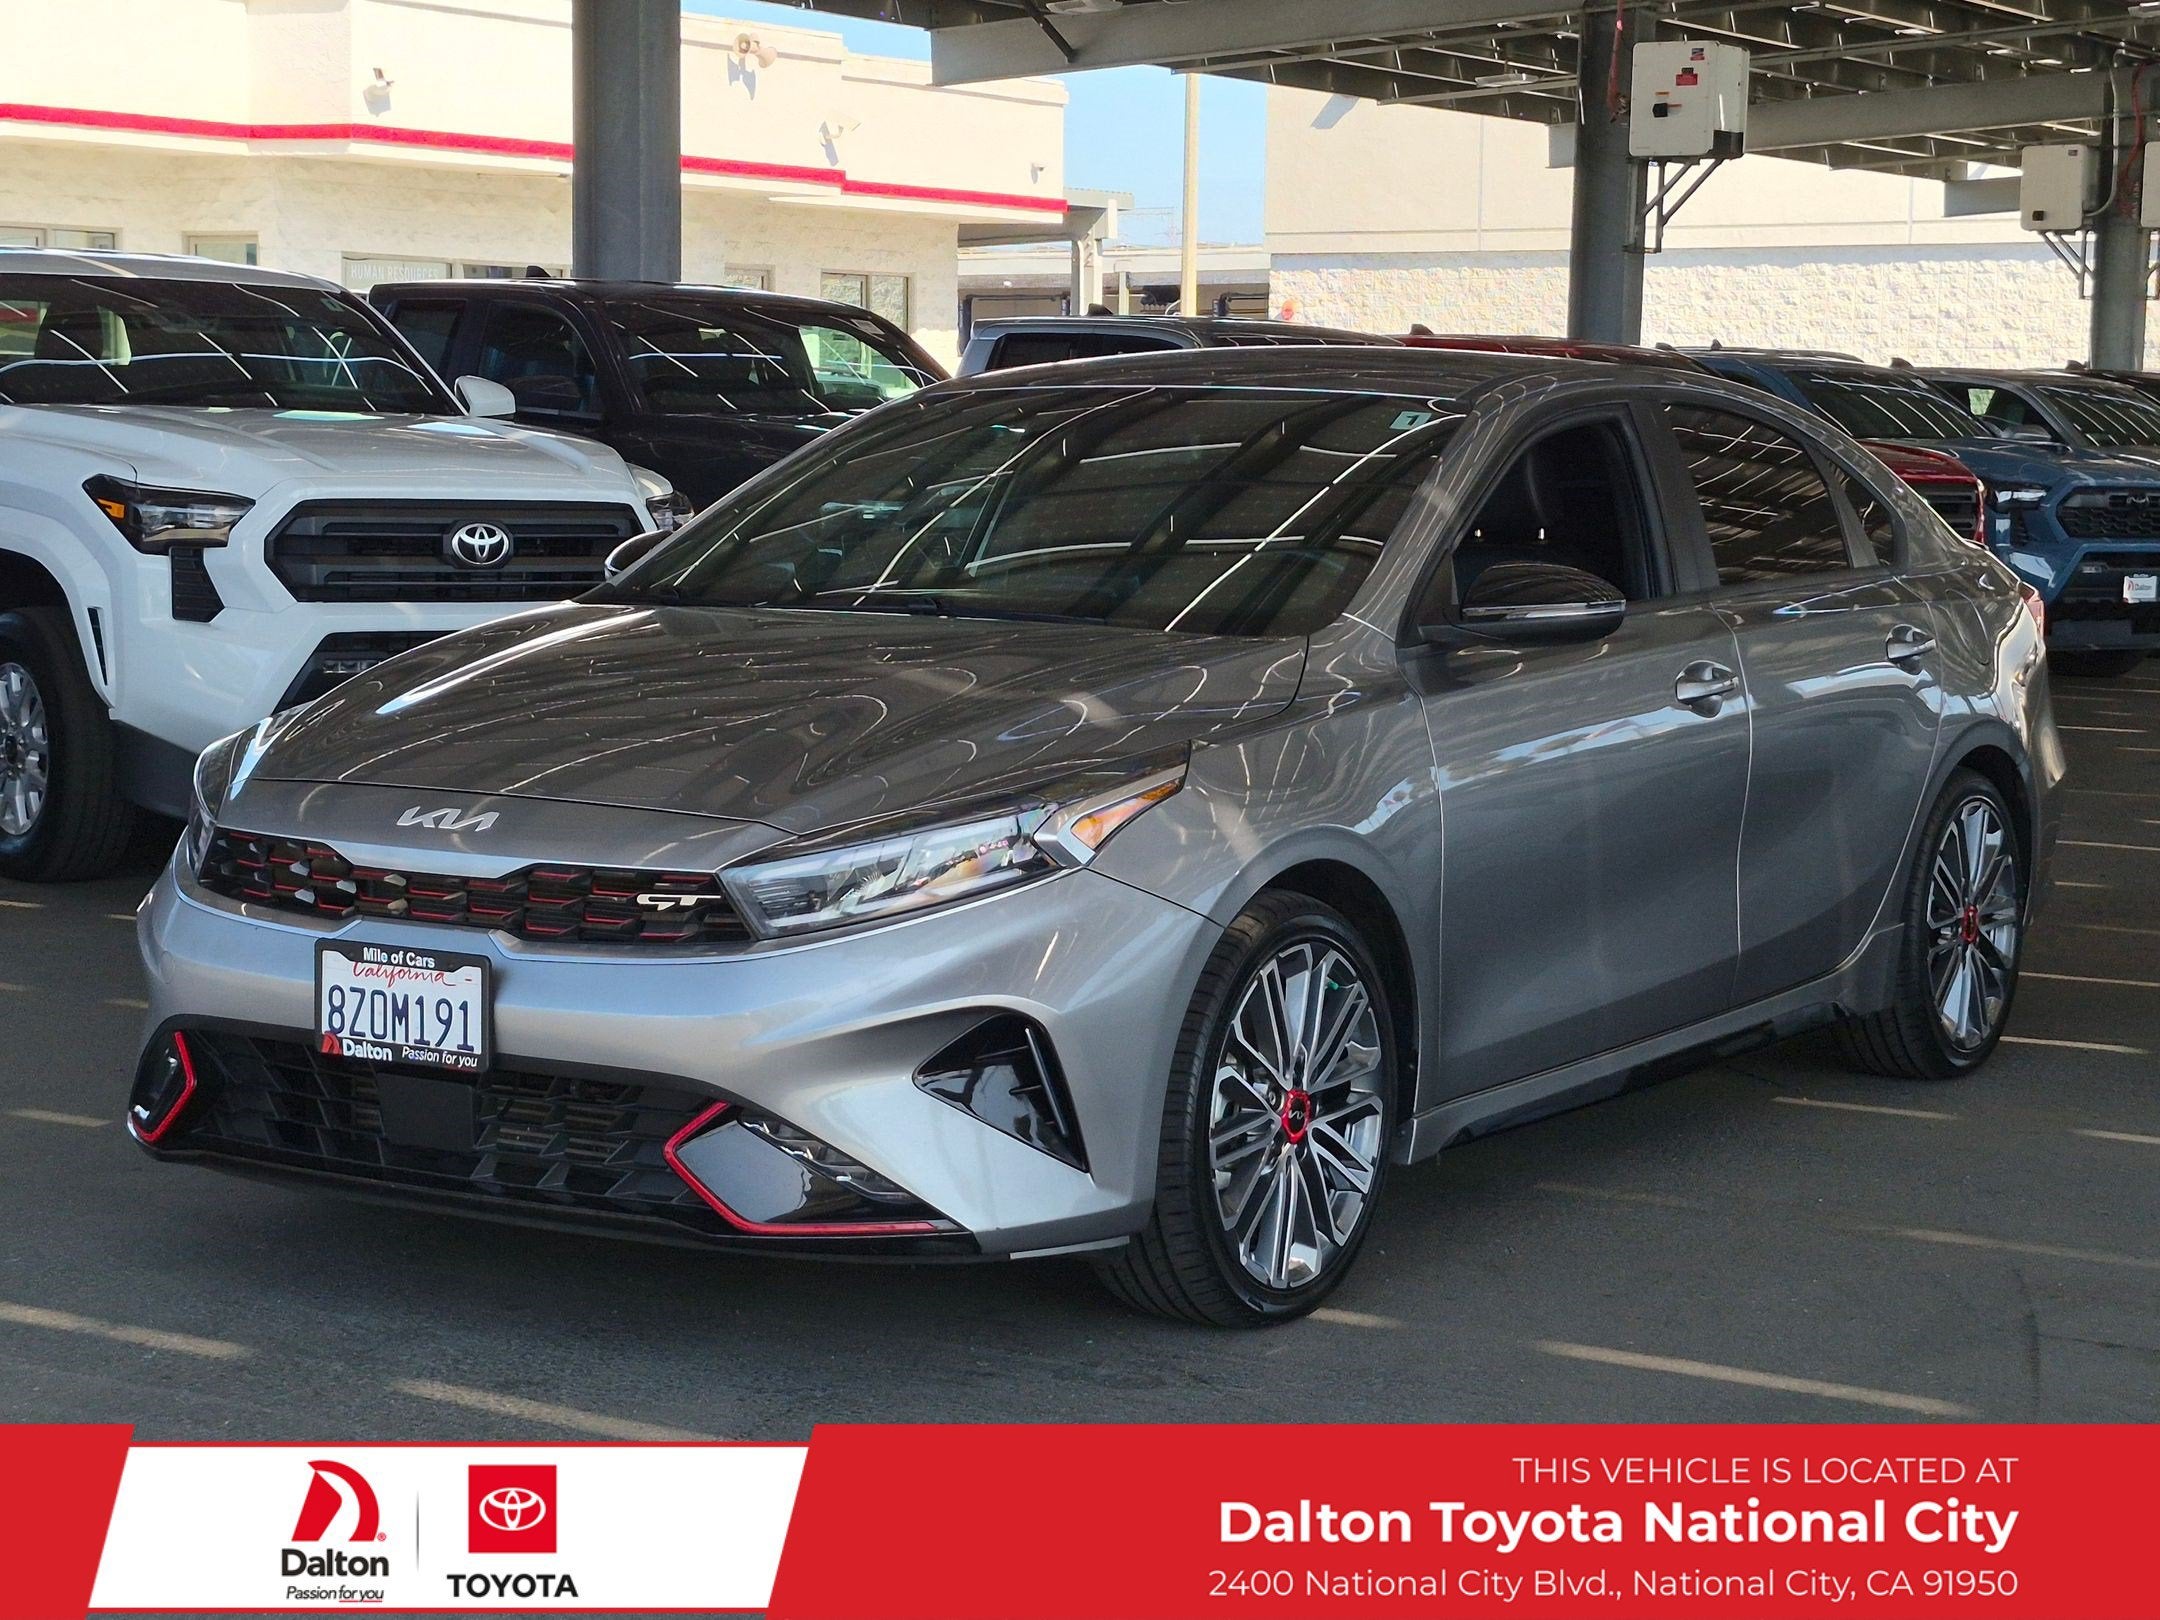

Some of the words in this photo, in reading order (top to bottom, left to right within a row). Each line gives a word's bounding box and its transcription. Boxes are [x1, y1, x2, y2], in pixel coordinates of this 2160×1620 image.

[351, 263, 384, 280] HUMAN
[396, 805, 500, 832] KIA
[636, 893, 721, 911] GT
[363, 946, 388, 963] Mile
[390, 951, 405, 965] of
[406, 952, 436, 969] Cars
[352, 961, 456, 988] California
[342, 1039, 393, 1062] Dalton
[401, 1046, 440, 1063] Passion
[441, 1050, 457, 1065] for
[457, 1054, 478, 1068] you
